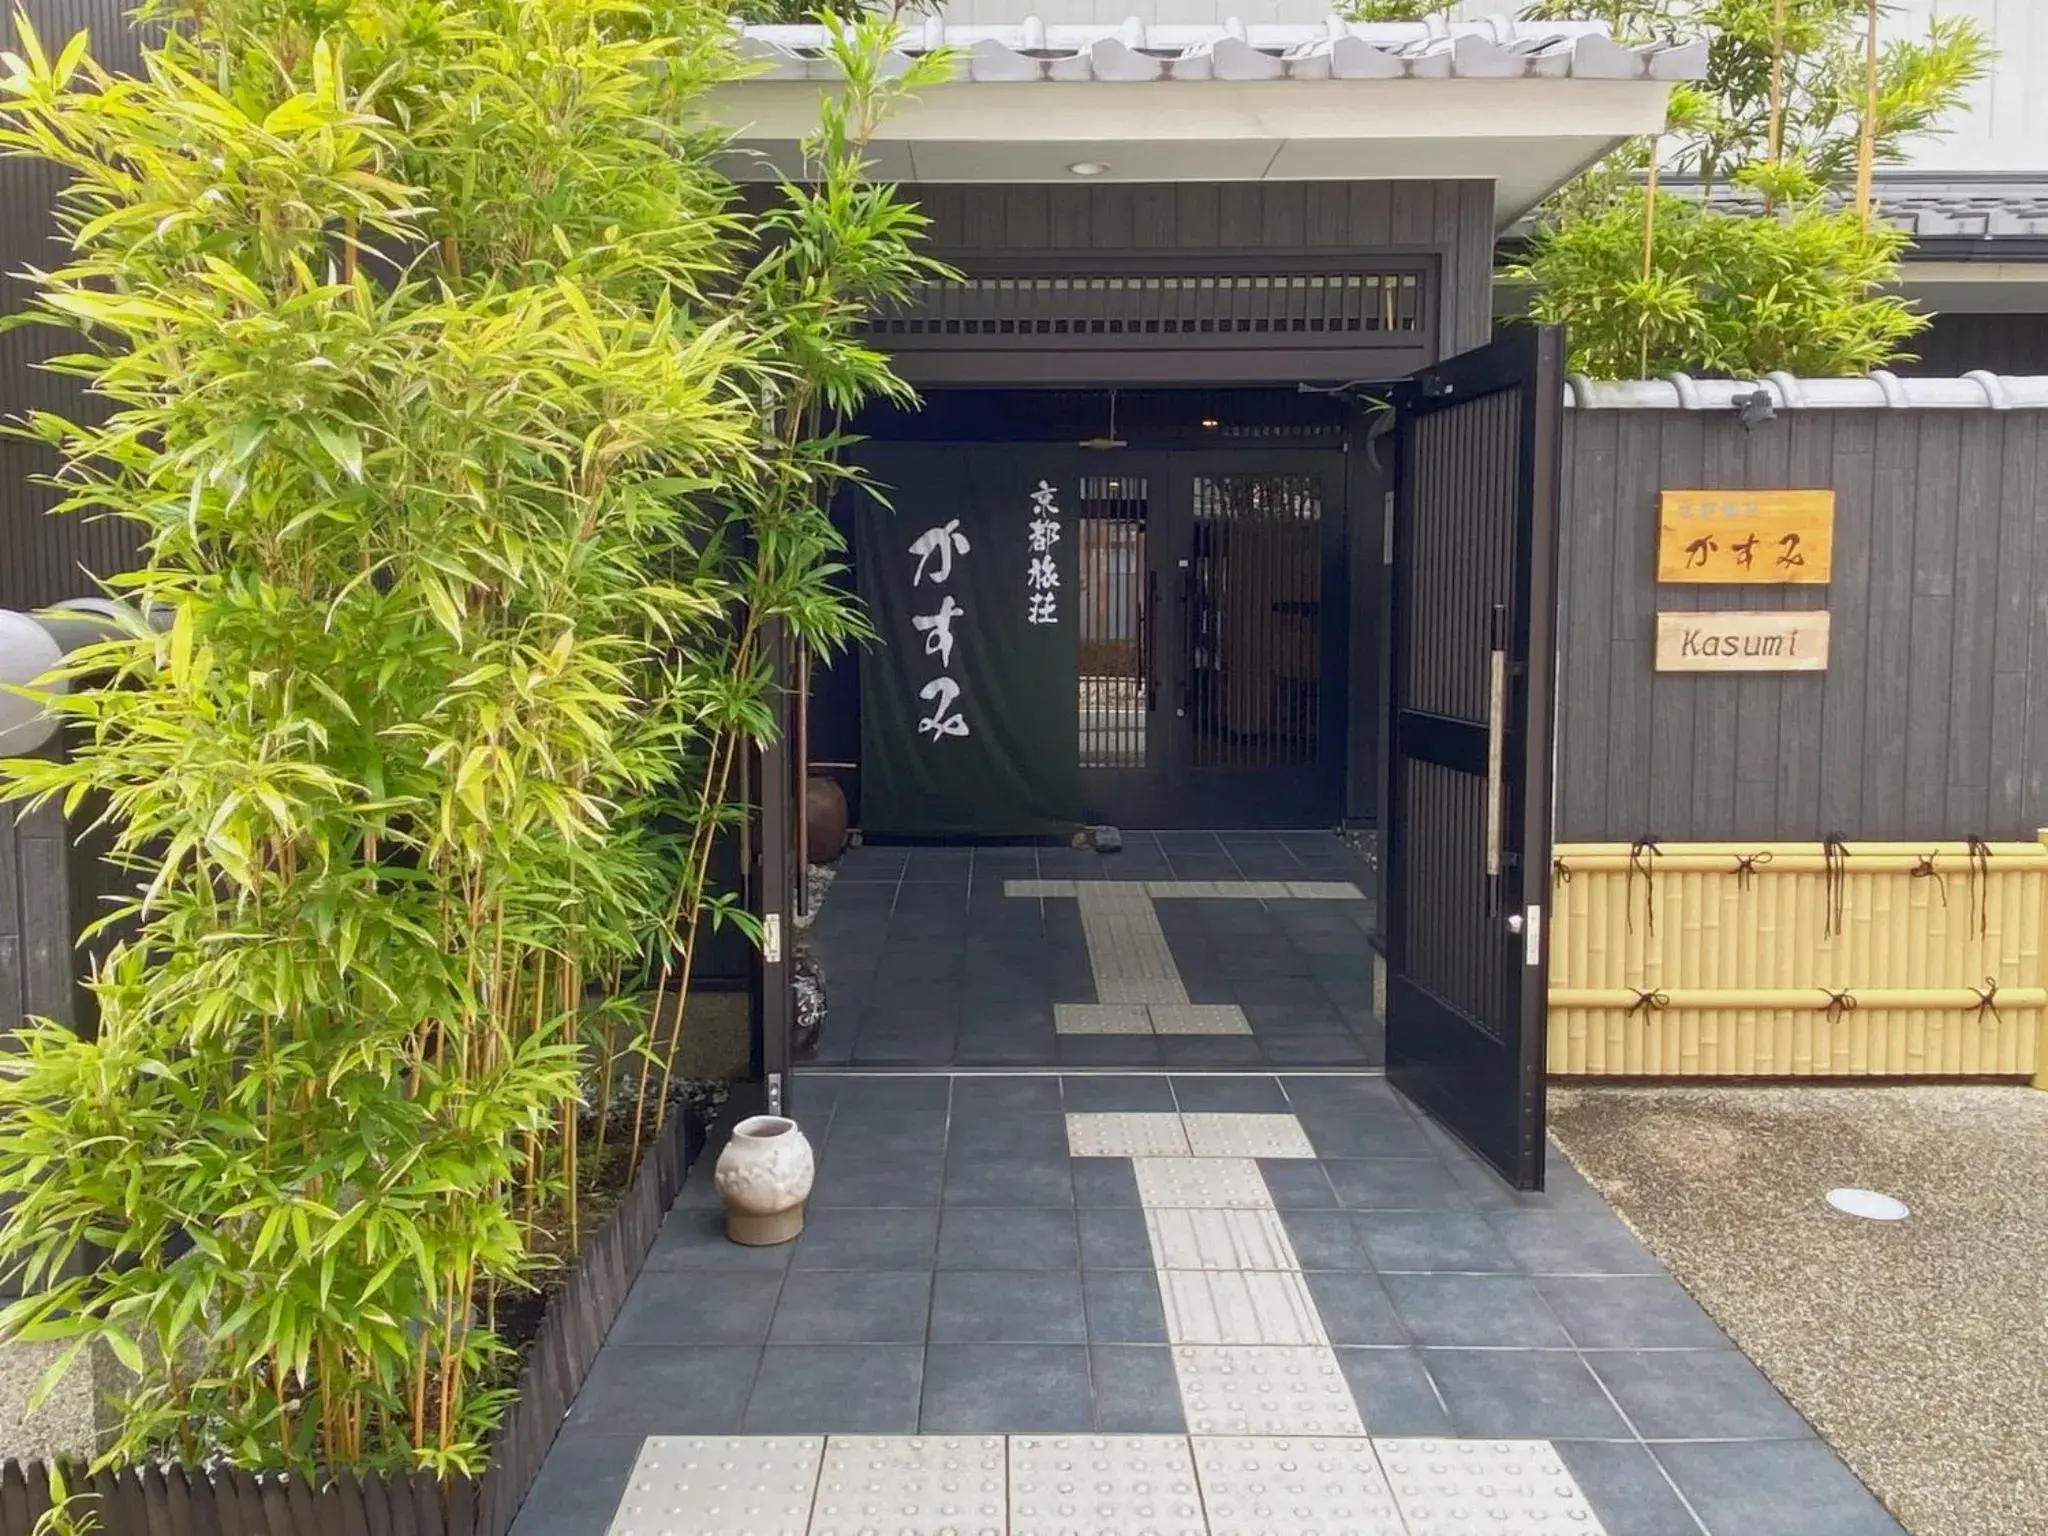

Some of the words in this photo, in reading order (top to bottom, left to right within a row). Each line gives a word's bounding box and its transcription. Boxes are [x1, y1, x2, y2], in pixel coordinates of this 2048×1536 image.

[1684, 532, 1805, 571] かすみ
[908, 518, 971, 743] かすみ
[1680, 628, 1800, 657] Kasumi
